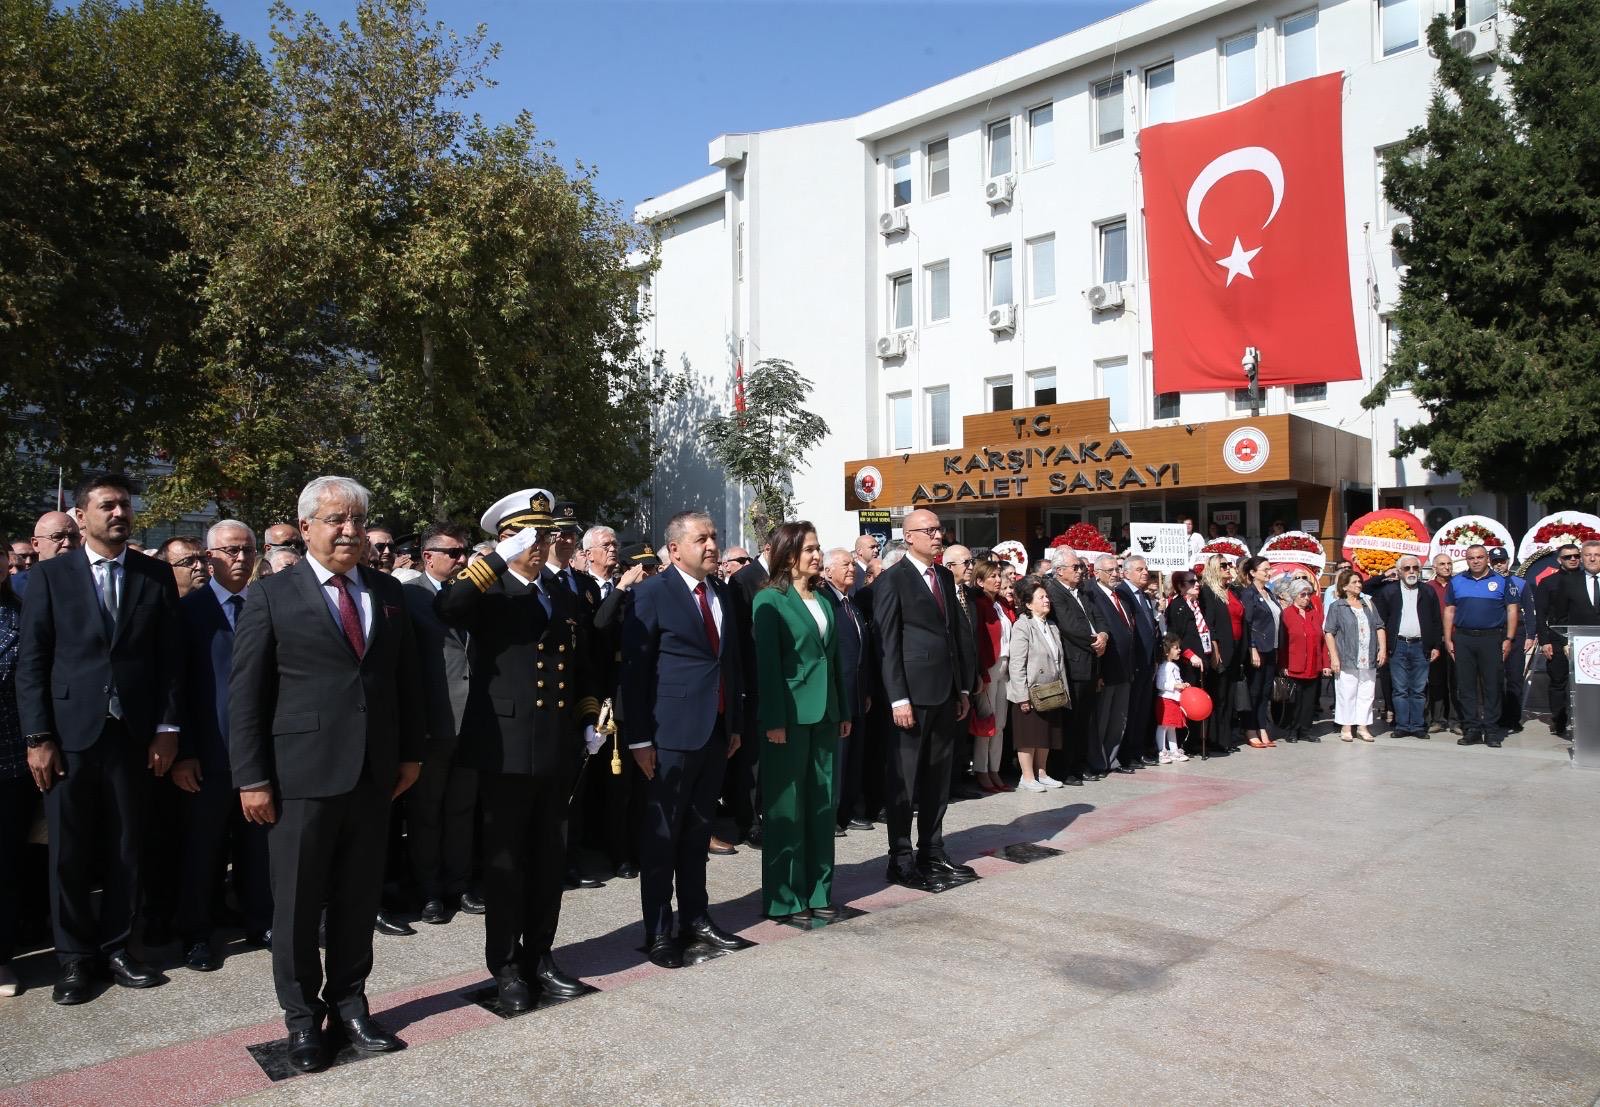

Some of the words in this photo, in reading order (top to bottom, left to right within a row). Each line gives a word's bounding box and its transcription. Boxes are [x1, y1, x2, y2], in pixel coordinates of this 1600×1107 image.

[1011, 413, 1060, 439] T.C.
[943, 438, 1132, 475] KARŞIYAKA
[912, 475, 1028, 504] ADALET
[1049, 463, 1180, 494] SARAYI
